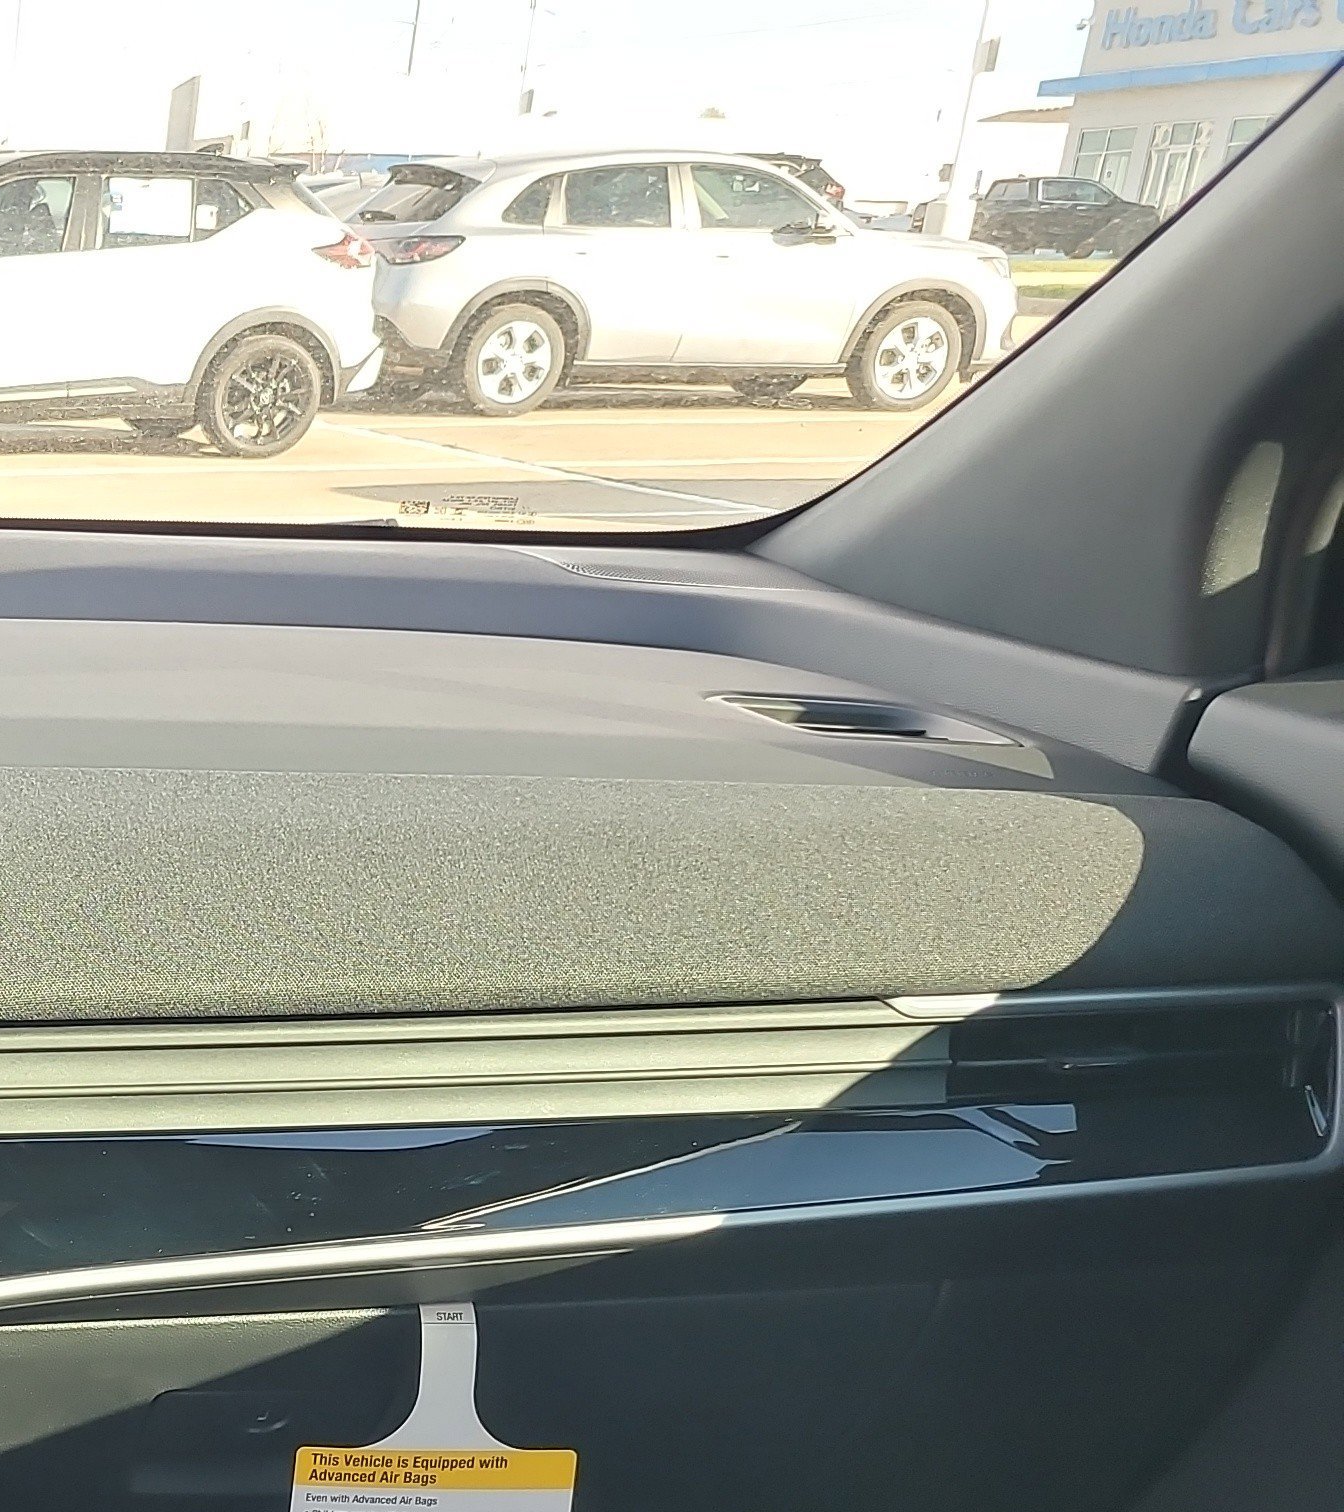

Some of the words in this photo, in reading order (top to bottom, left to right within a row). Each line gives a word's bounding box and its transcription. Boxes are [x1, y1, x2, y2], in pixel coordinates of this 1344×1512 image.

[1101, 0, 1217, 50] Honda
[1232, 0, 1323, 35] Cars
[436, 1311, 464, 1321] START
[311, 1453, 340, 1467] This
[344, 1454, 393, 1468] Vehicle
[397, 1456, 409, 1468] is
[412, 1456, 475, 1471] Equipped
[479, 1456, 508, 1469] with
[308, 1469, 376, 1483] Advanced
[379, 1471, 400, 1484] Air
[403, 1472, 437, 1486] Bags
[305, 1493, 327, 1502] Even
[330, 1494, 350, 1503] with
[352, 1495, 397, 1505] Advanced
[399, 1496, 413, 1505] Air
[414, 1496, 438, 1507] Bags
